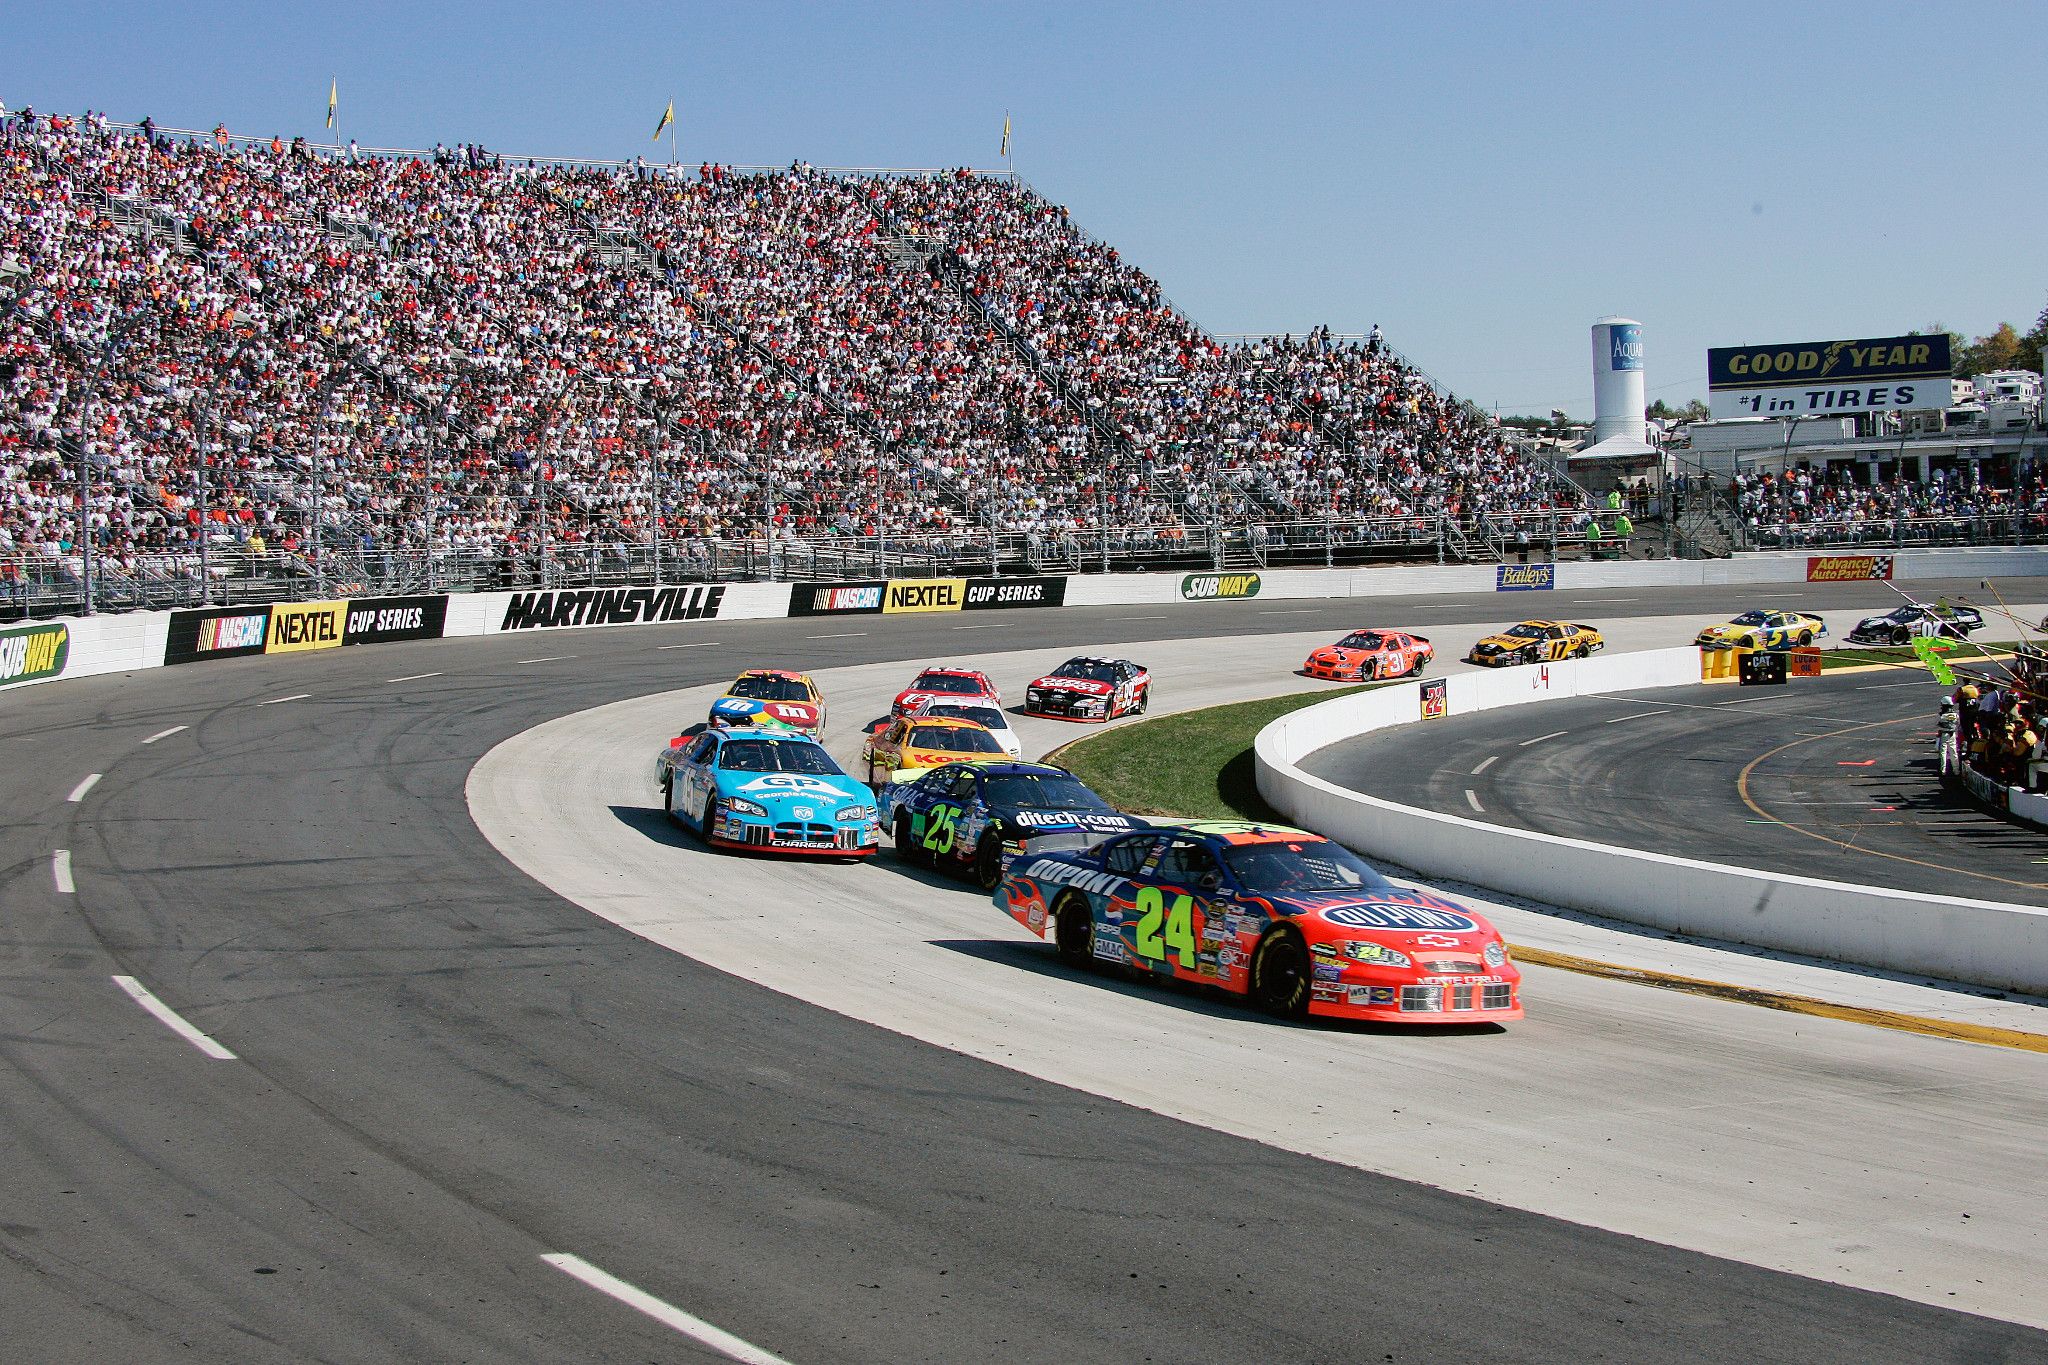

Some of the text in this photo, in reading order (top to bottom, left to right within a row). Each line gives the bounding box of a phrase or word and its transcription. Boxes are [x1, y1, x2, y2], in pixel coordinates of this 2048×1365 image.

[1728, 344, 1930, 375] GOOD YEAR
[1739, 386, 1915, 412] #1 in TIRES
[1809, 569, 1837, 580] Auto
[1816, 557, 1870, 570] Advance
[834, 587, 880, 609] NASCAR
[891, 585, 956, 608] NEXTEL
[968, 586, 995, 603] CUP
[1185, 574, 1257, 599] SUBWAY
[501, 586, 727, 631] MARTINSVILLE
[217, 615, 263, 648] NASCAR
[274, 611, 338, 645] NEXTEL
[348, 611, 373, 634] CUP
[1766, 632, 1783, 646] 5
[0, 627, 67, 680] SUBWAY
[1550, 641, 1568, 660] 17
[1389, 653, 1405, 673] 31
[1753, 656, 1772, 668] CAT
[1541, 665, 1549, 689] 4
[719, 700, 754, 711] m
[776, 705, 810, 719] m
[923, 803, 962, 854] 25
[1015, 811, 1130, 827] ditech.com
[771, 840, 835, 849] CHARGER
[1025, 859, 1131, 896] DUPONT
[1136, 886, 1196, 969] 24
[1356, 946, 1382, 958] 24
